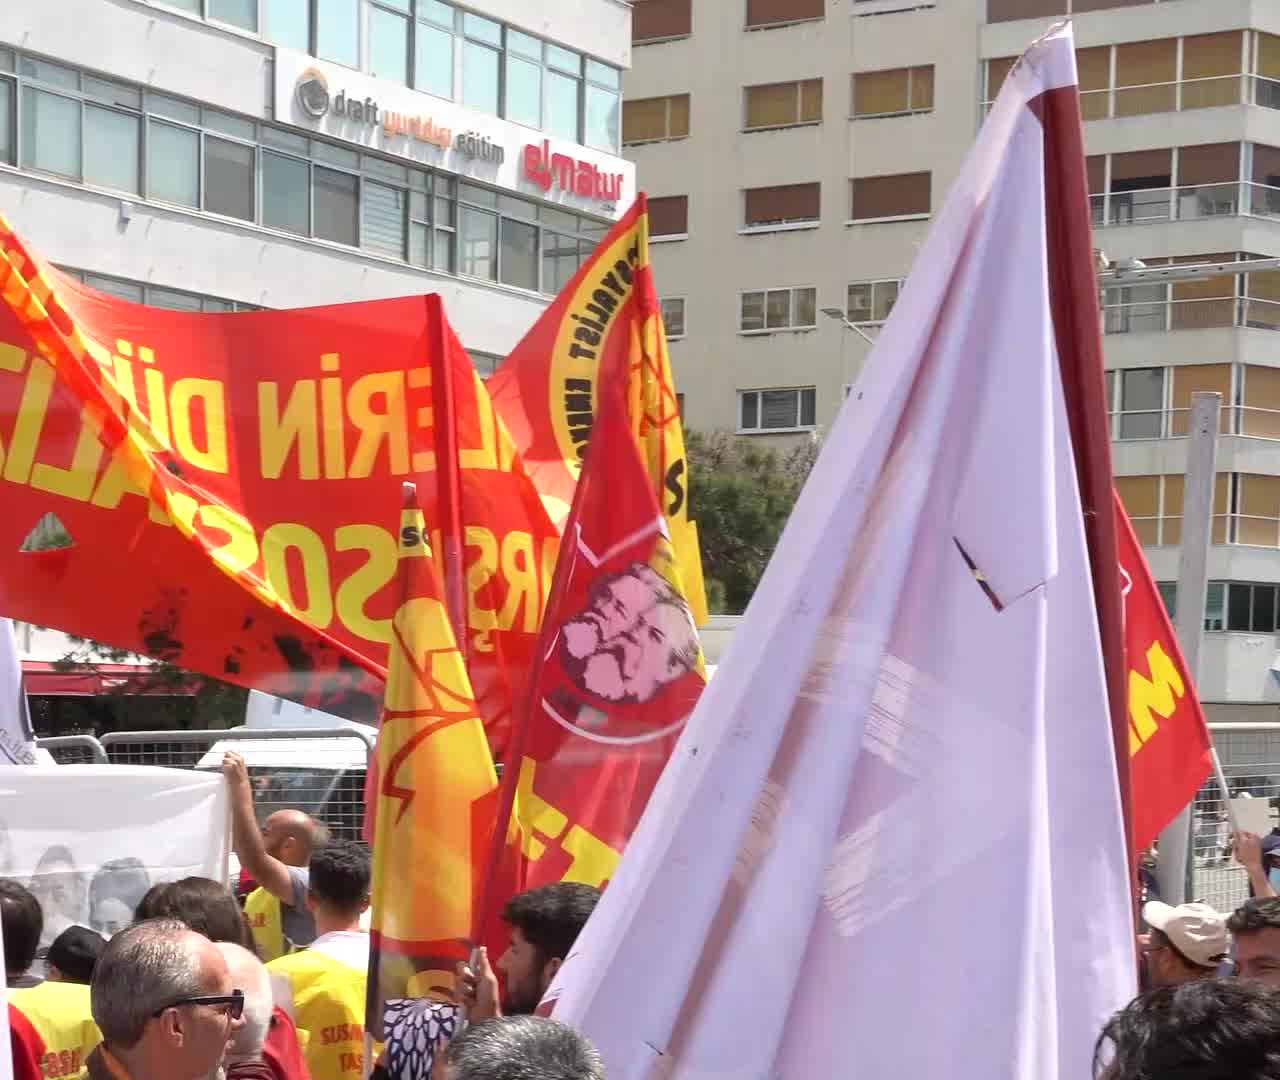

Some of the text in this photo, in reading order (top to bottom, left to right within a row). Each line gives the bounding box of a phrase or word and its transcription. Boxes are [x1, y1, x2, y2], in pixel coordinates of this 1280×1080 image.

[334, 88, 380, 125] draft
[455, 129, 505, 165] eğitim
[524, 138, 624, 200] elmatur
